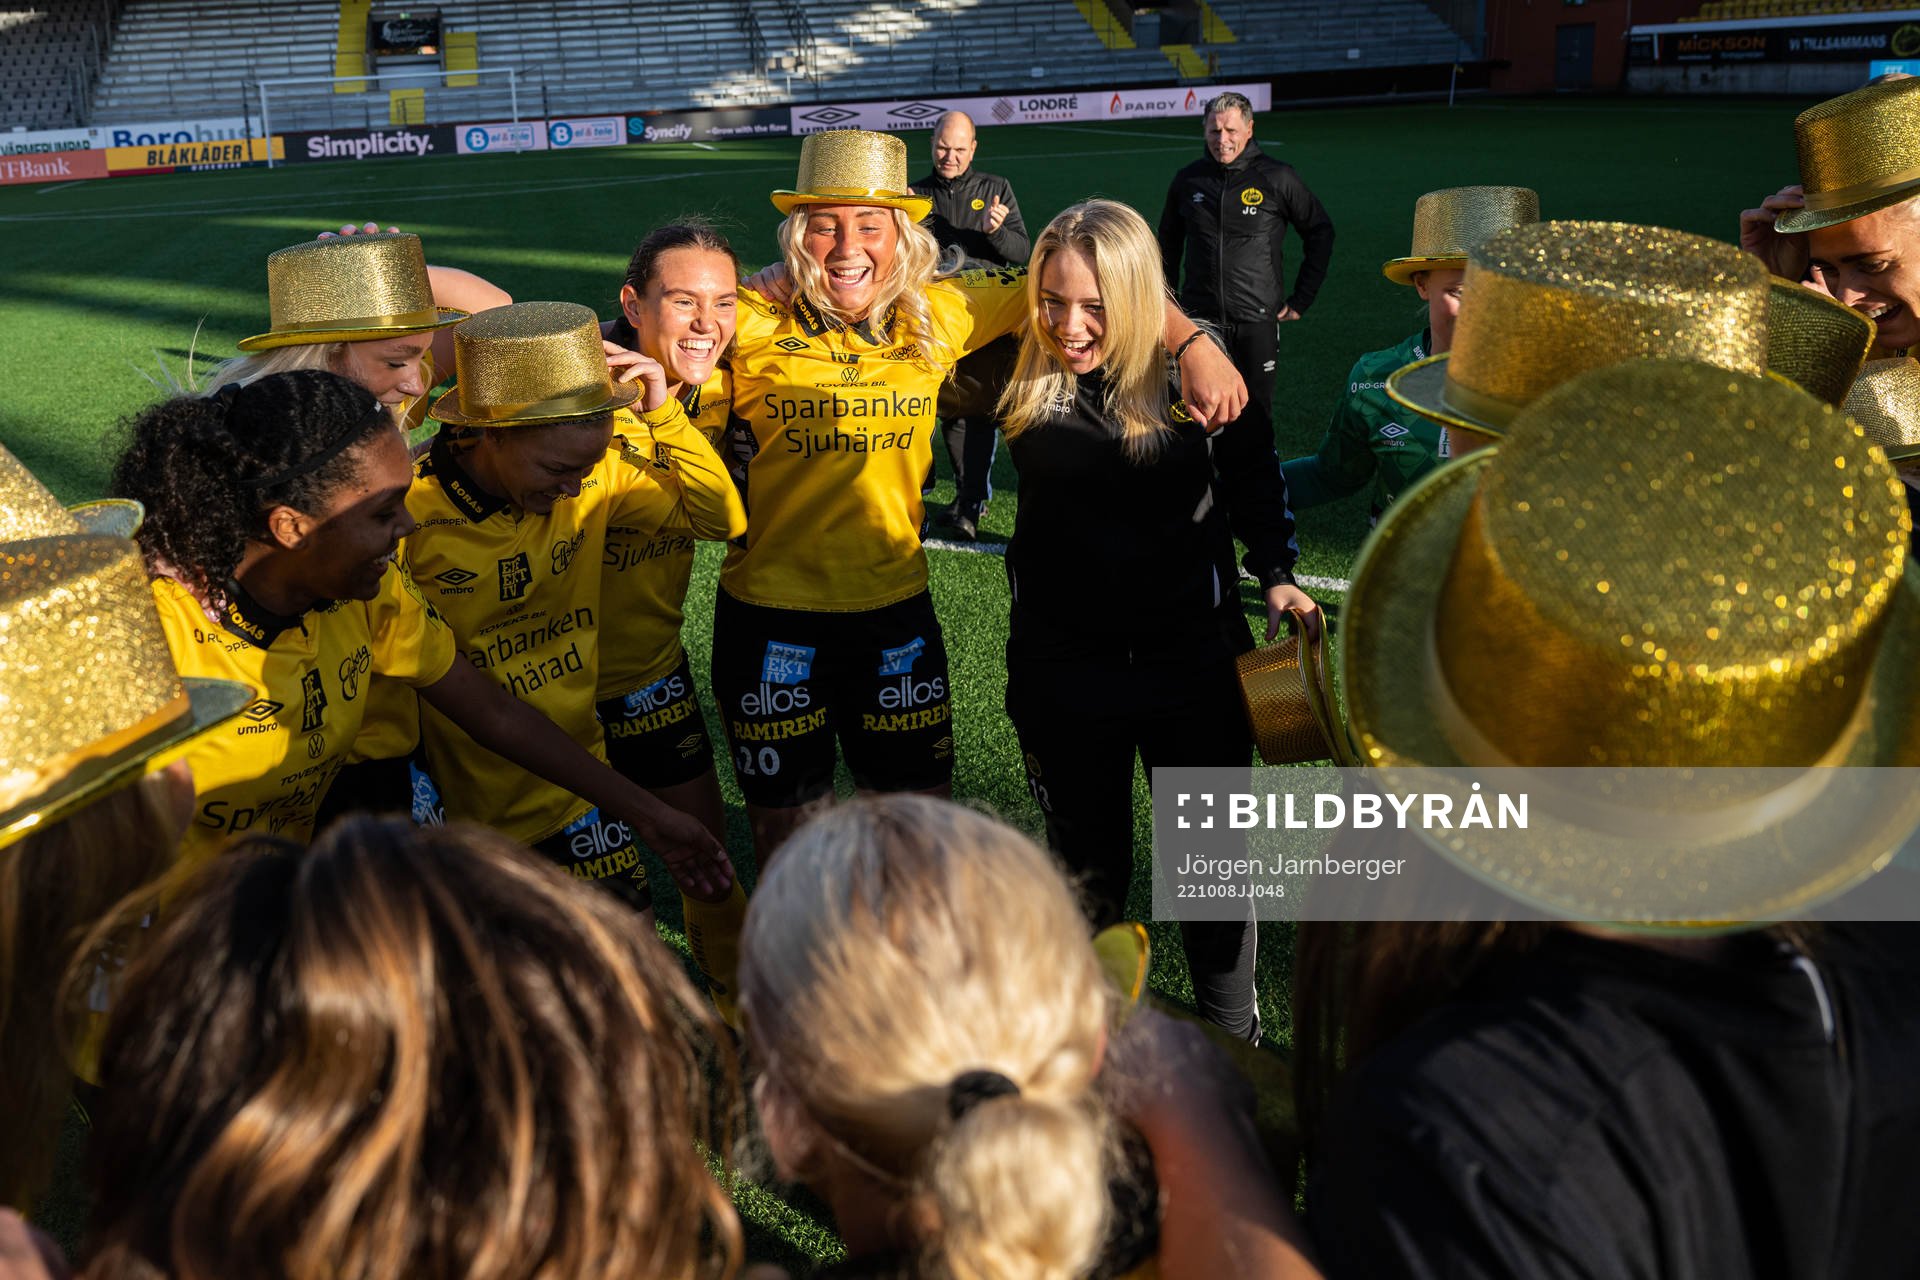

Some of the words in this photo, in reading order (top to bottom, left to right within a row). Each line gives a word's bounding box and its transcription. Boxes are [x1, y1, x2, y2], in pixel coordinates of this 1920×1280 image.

[1019, 94, 1078, 112] LONDRÉ
[644, 123, 693, 142] Syncify
[147, 144, 243, 166] BLÅKLÄDER
[1242, 206, 1257, 216] JC
[764, 390, 932, 425] Sparbanken
[785, 426, 915, 459] Sjuhärad
[440, 586, 474, 595] umbro
[469, 607, 594, 669] arbanken
[502, 641, 584, 697] härad
[767, 658, 809, 677] EKT
[740, 682, 811, 717] ellos
[878, 675, 945, 709] ellos
[237, 721, 279, 736] umbro
[608, 692, 698, 740] RAMIREN
[732, 706, 830, 741] RAMIRENT
[862, 703, 950, 732] RAMIREN
[736, 745, 781, 777] 20
